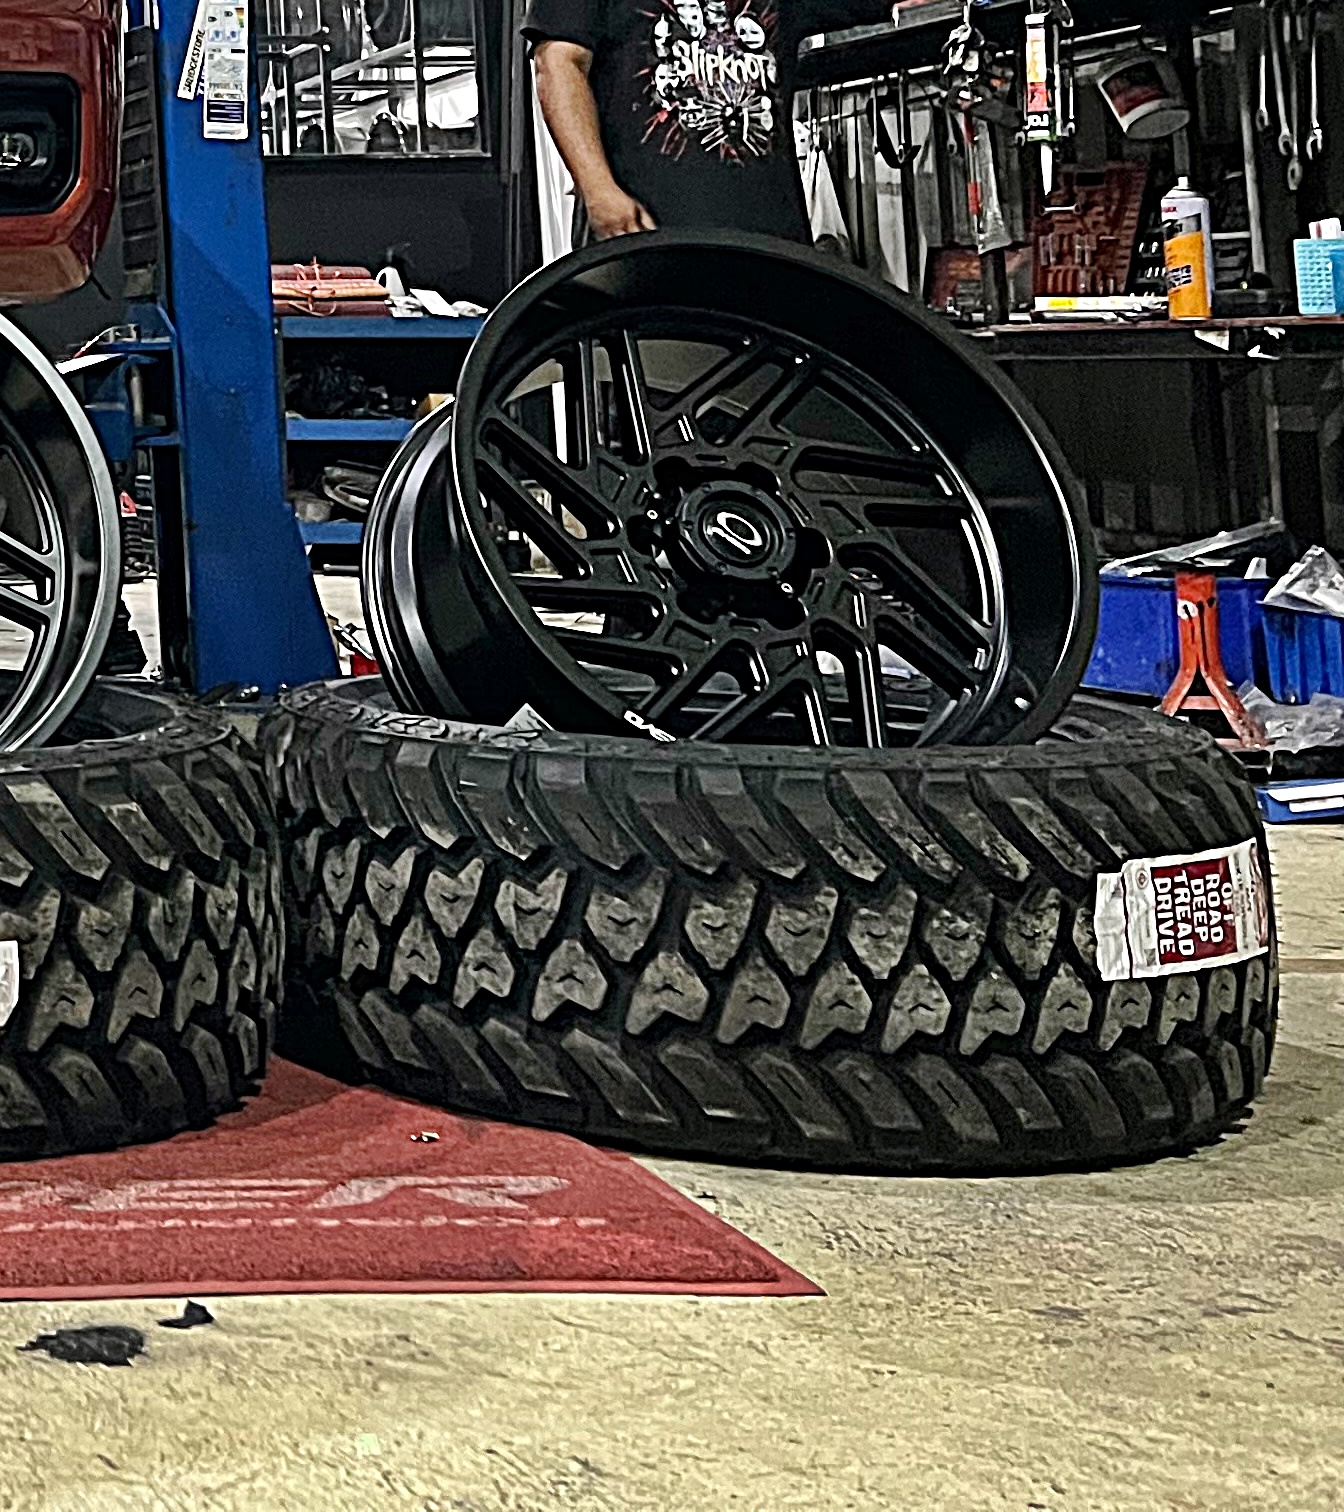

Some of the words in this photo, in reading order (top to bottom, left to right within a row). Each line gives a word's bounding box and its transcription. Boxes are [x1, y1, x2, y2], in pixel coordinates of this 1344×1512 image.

[1153, 877, 1177, 956] DRIVE
[1173, 869, 1196, 957] TREAD
[1189, 878, 1209, 943] DEEP
[1204, 873, 1225, 943] ROAD
